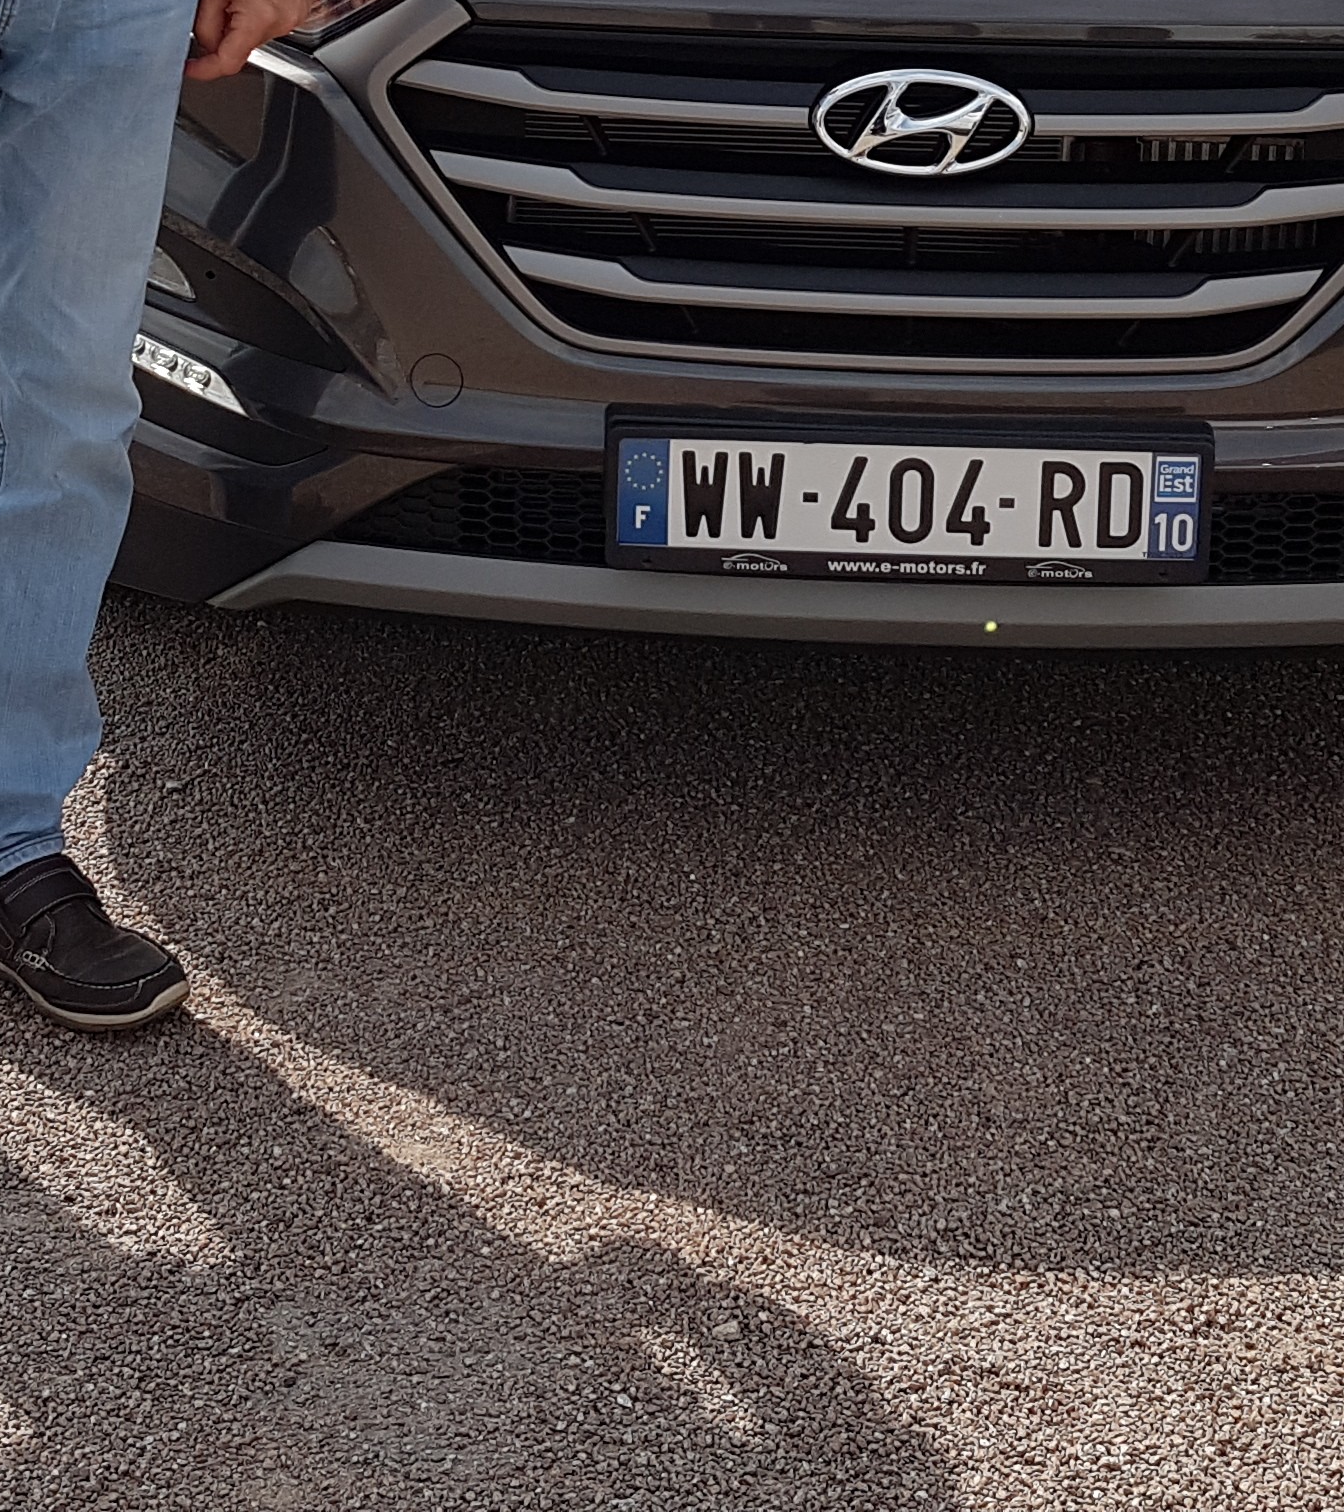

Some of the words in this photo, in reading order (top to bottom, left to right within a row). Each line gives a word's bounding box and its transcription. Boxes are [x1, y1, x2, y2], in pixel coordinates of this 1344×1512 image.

[1159, 464, 1195, 474] Grand
[1158, 474, 1194, 493] Est
[682, 450, 1144, 549] WW-404-RD
[634, 505, 652, 529] F
[1154, 513, 1194, 552] 10
[827, 559, 987, 575] www.e-motors.fr
